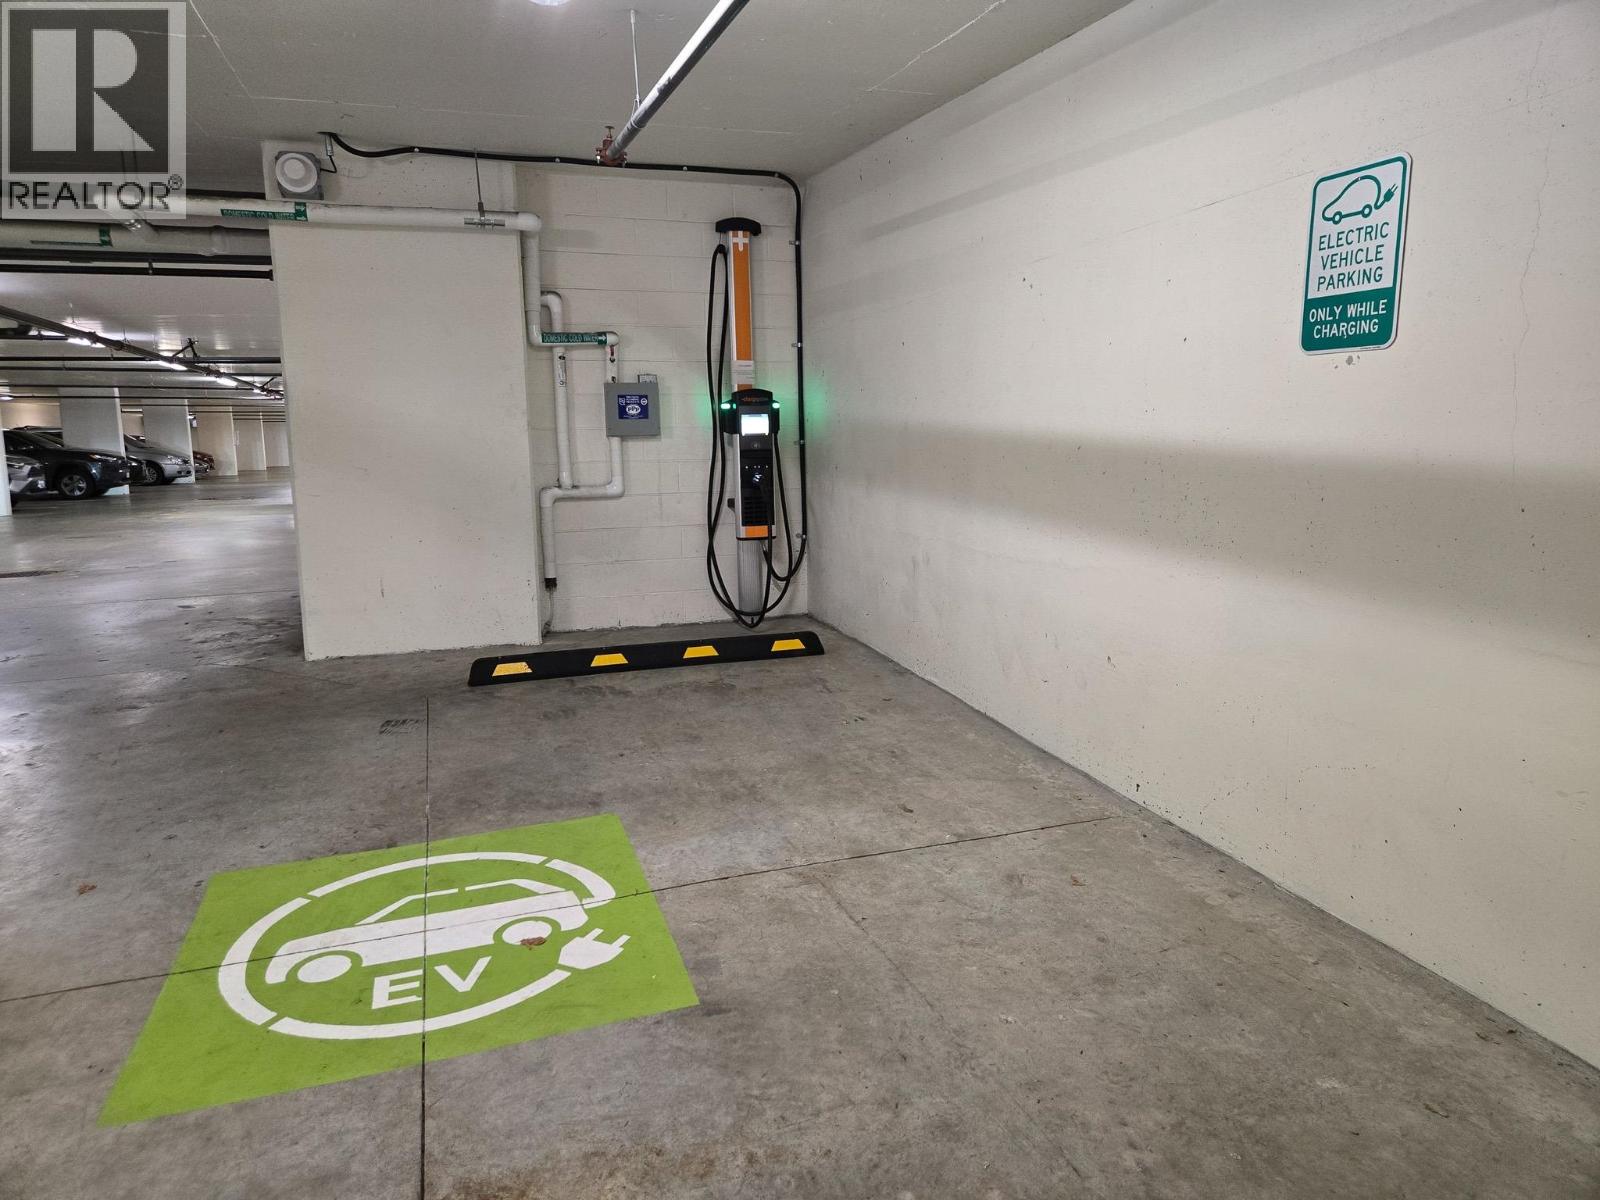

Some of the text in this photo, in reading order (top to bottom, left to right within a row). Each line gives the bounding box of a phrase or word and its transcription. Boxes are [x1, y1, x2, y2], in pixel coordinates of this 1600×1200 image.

[1318, 222, 1390, 251] ELECTRIC
[1321, 244, 1384, 270] VEHICLE
[1317, 266, 1383, 292] PARKING
[1309, 299, 1388, 323] ONLY WHILE
[543, 333, 599, 343] DOMESTIC COLD WATER
[1313, 318, 1379, 339] CHARGING
[371, 956, 492, 1009] EV
